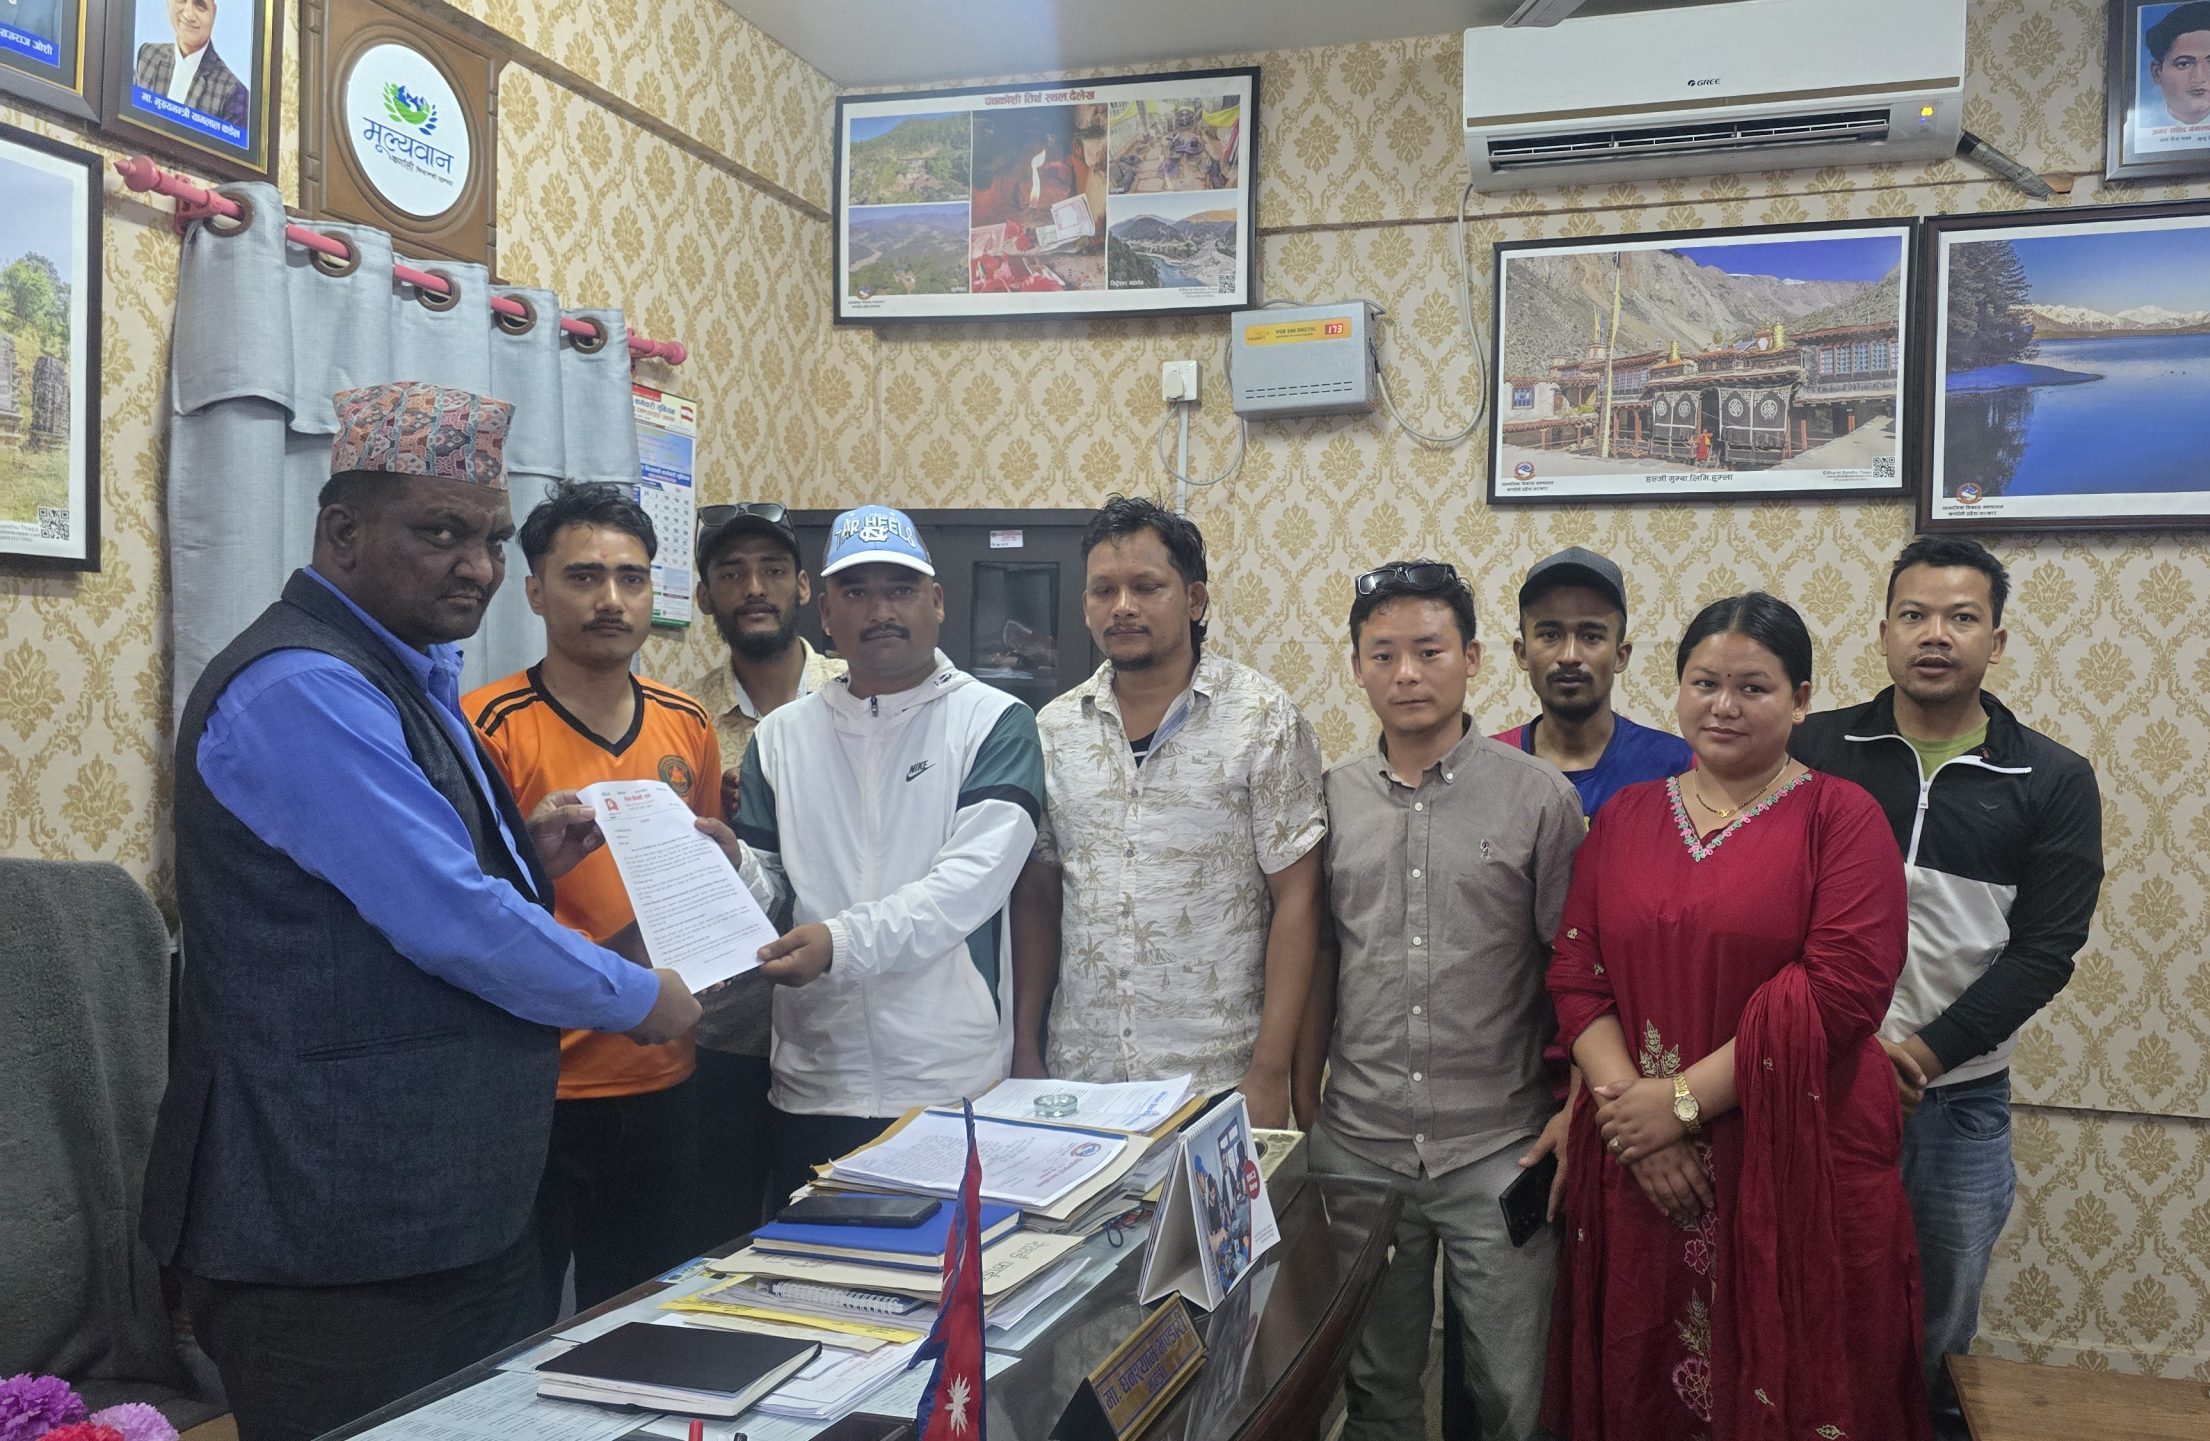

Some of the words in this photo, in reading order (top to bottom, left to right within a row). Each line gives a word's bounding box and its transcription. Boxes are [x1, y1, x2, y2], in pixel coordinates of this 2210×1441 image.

[32, 40, 53, 56] जोशी
[1697, 78, 1720, 86] GREE
[154, 97, 190, 119] मुख्यमन्त्री
[191, 112, 221, 131] यामलाल
[363, 116, 454, 174] मूल्यवान
[1328, 324, 1342, 334] 173
[835, 519, 860, 550] TAR
[864, 516, 916, 548] HEELS
[910, 760, 928, 772] NIKE
[1104, 1386, 1122, 1410] मा.
[1120, 1345, 1159, 1394] घनश्याम
[1156, 1310, 1188, 1355] भण्डारी
